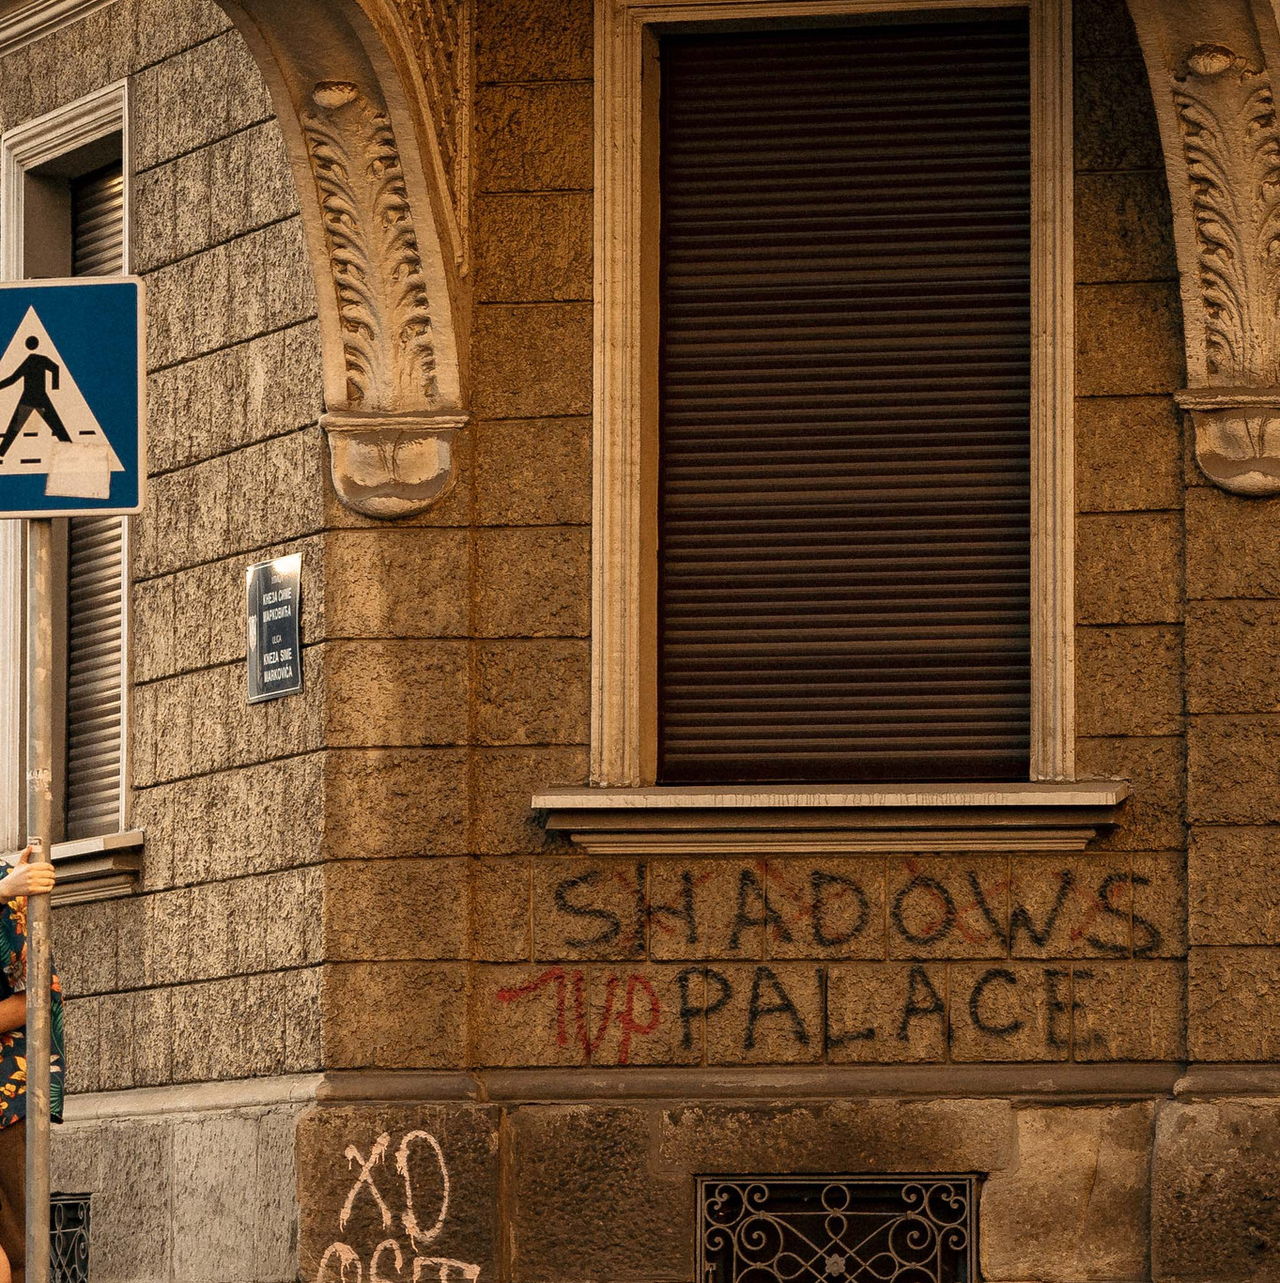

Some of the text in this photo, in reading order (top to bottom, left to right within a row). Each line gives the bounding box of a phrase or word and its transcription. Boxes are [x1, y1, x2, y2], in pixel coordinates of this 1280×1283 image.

[263, 647, 292, 665] KNEZA SIME
[263, 663, 293, 683] MARKOVIĆA
[555, 863, 1160, 957] SHADOWS
[677, 965, 1105, 1051] PALACE
